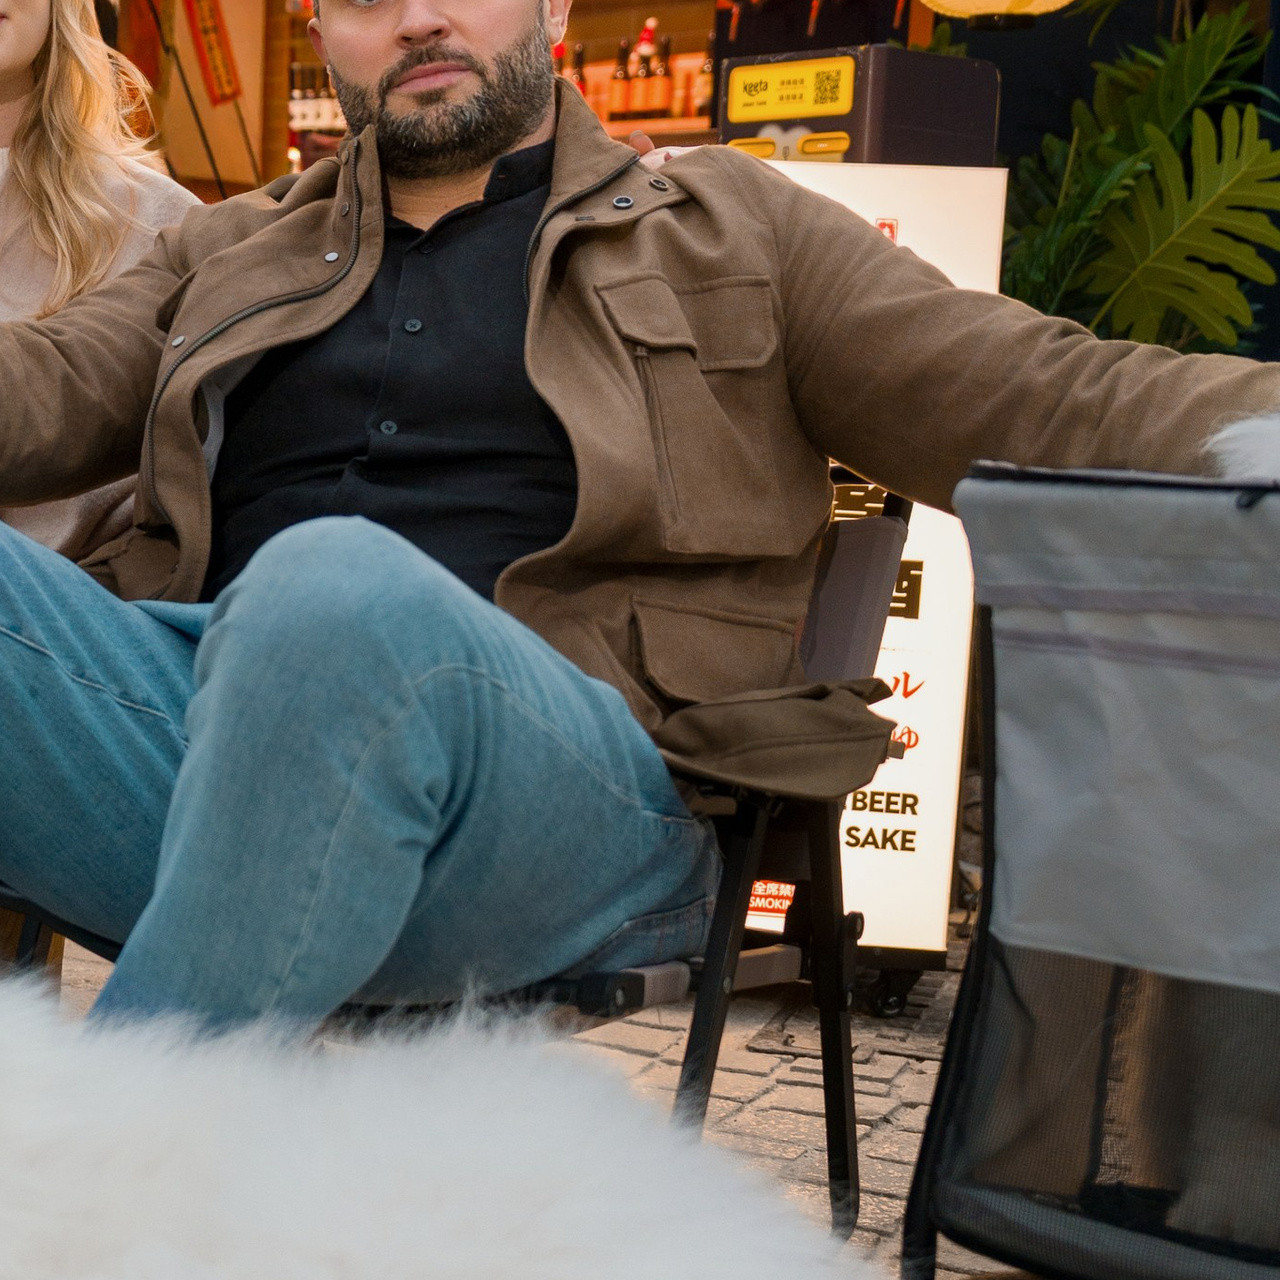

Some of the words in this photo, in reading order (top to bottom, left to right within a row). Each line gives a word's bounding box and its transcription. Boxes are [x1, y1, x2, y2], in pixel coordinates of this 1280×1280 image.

[742, 79, 769, 95] keeta
[851, 790, 920, 816] BEER
[845, 825, 917, 852] SAKE
[749, 896, 793, 910] SMOKIN
